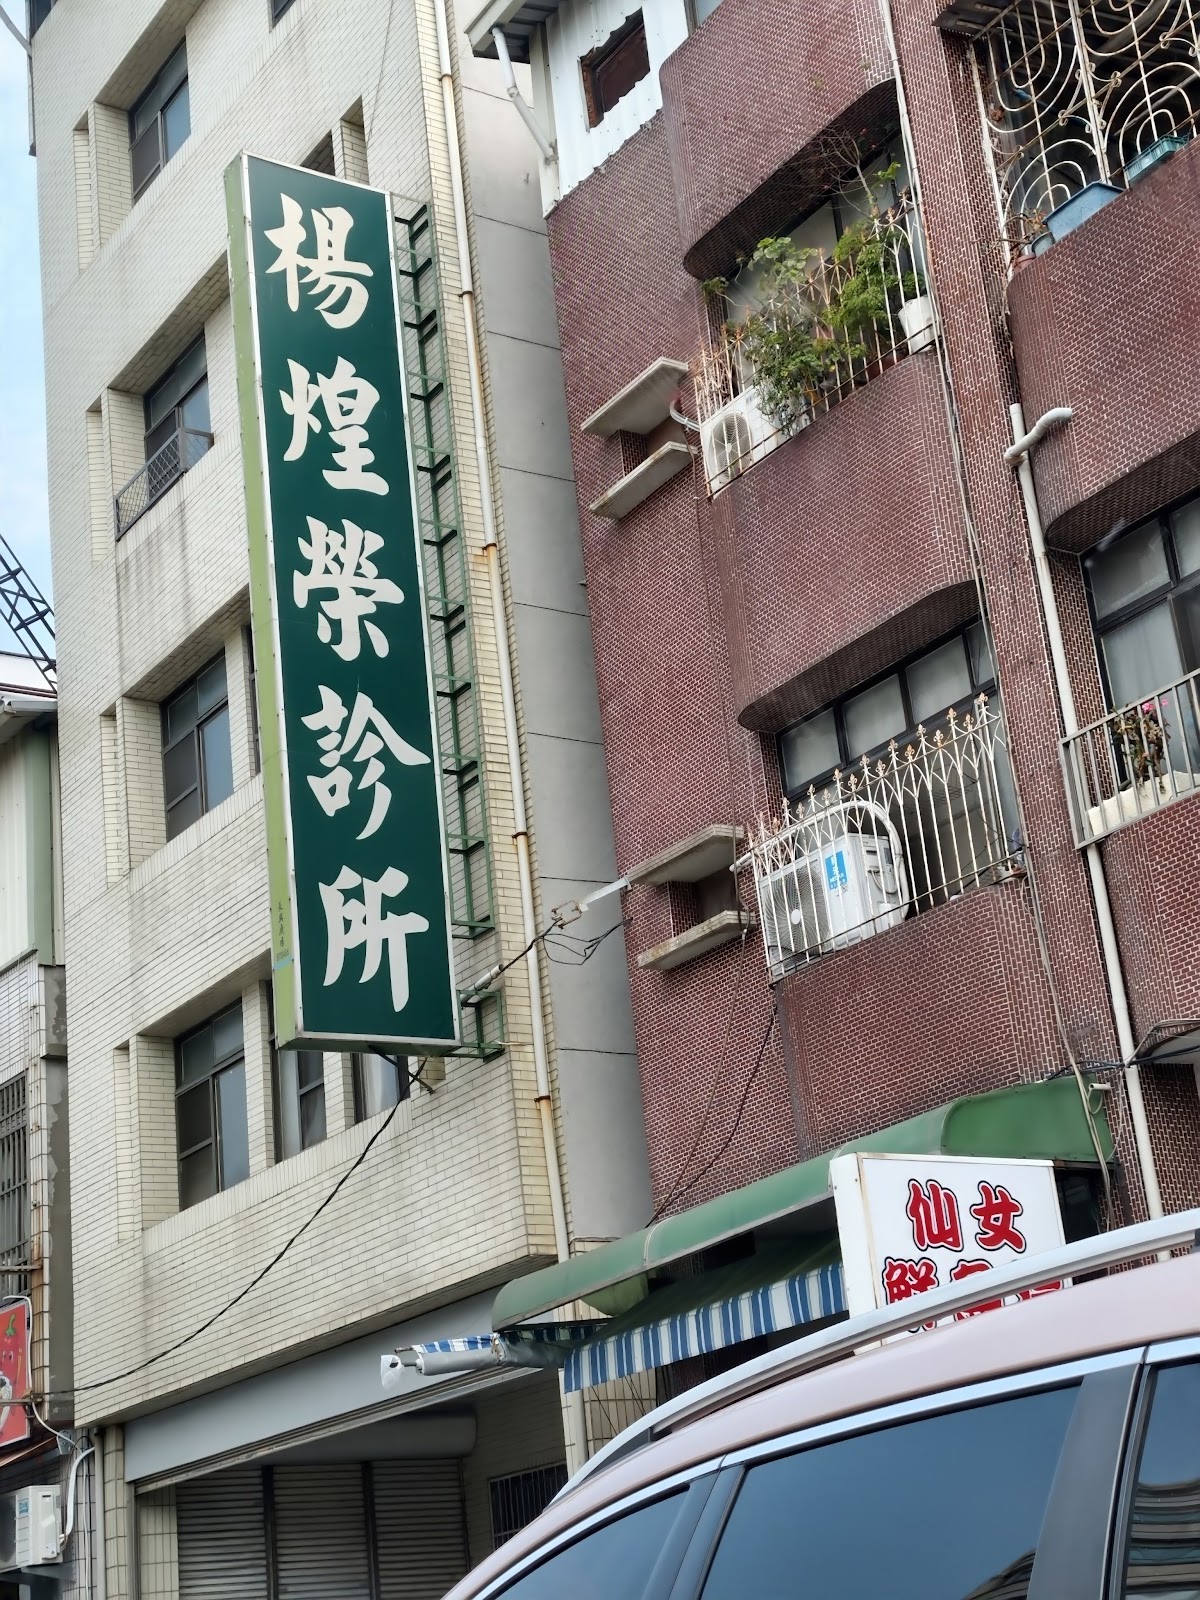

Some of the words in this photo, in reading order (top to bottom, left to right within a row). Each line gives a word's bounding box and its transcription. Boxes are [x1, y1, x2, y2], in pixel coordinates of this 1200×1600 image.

[264, 193, 431, 1012] 楊煌榮診所
[906, 1179, 1027, 1254] 仙女
